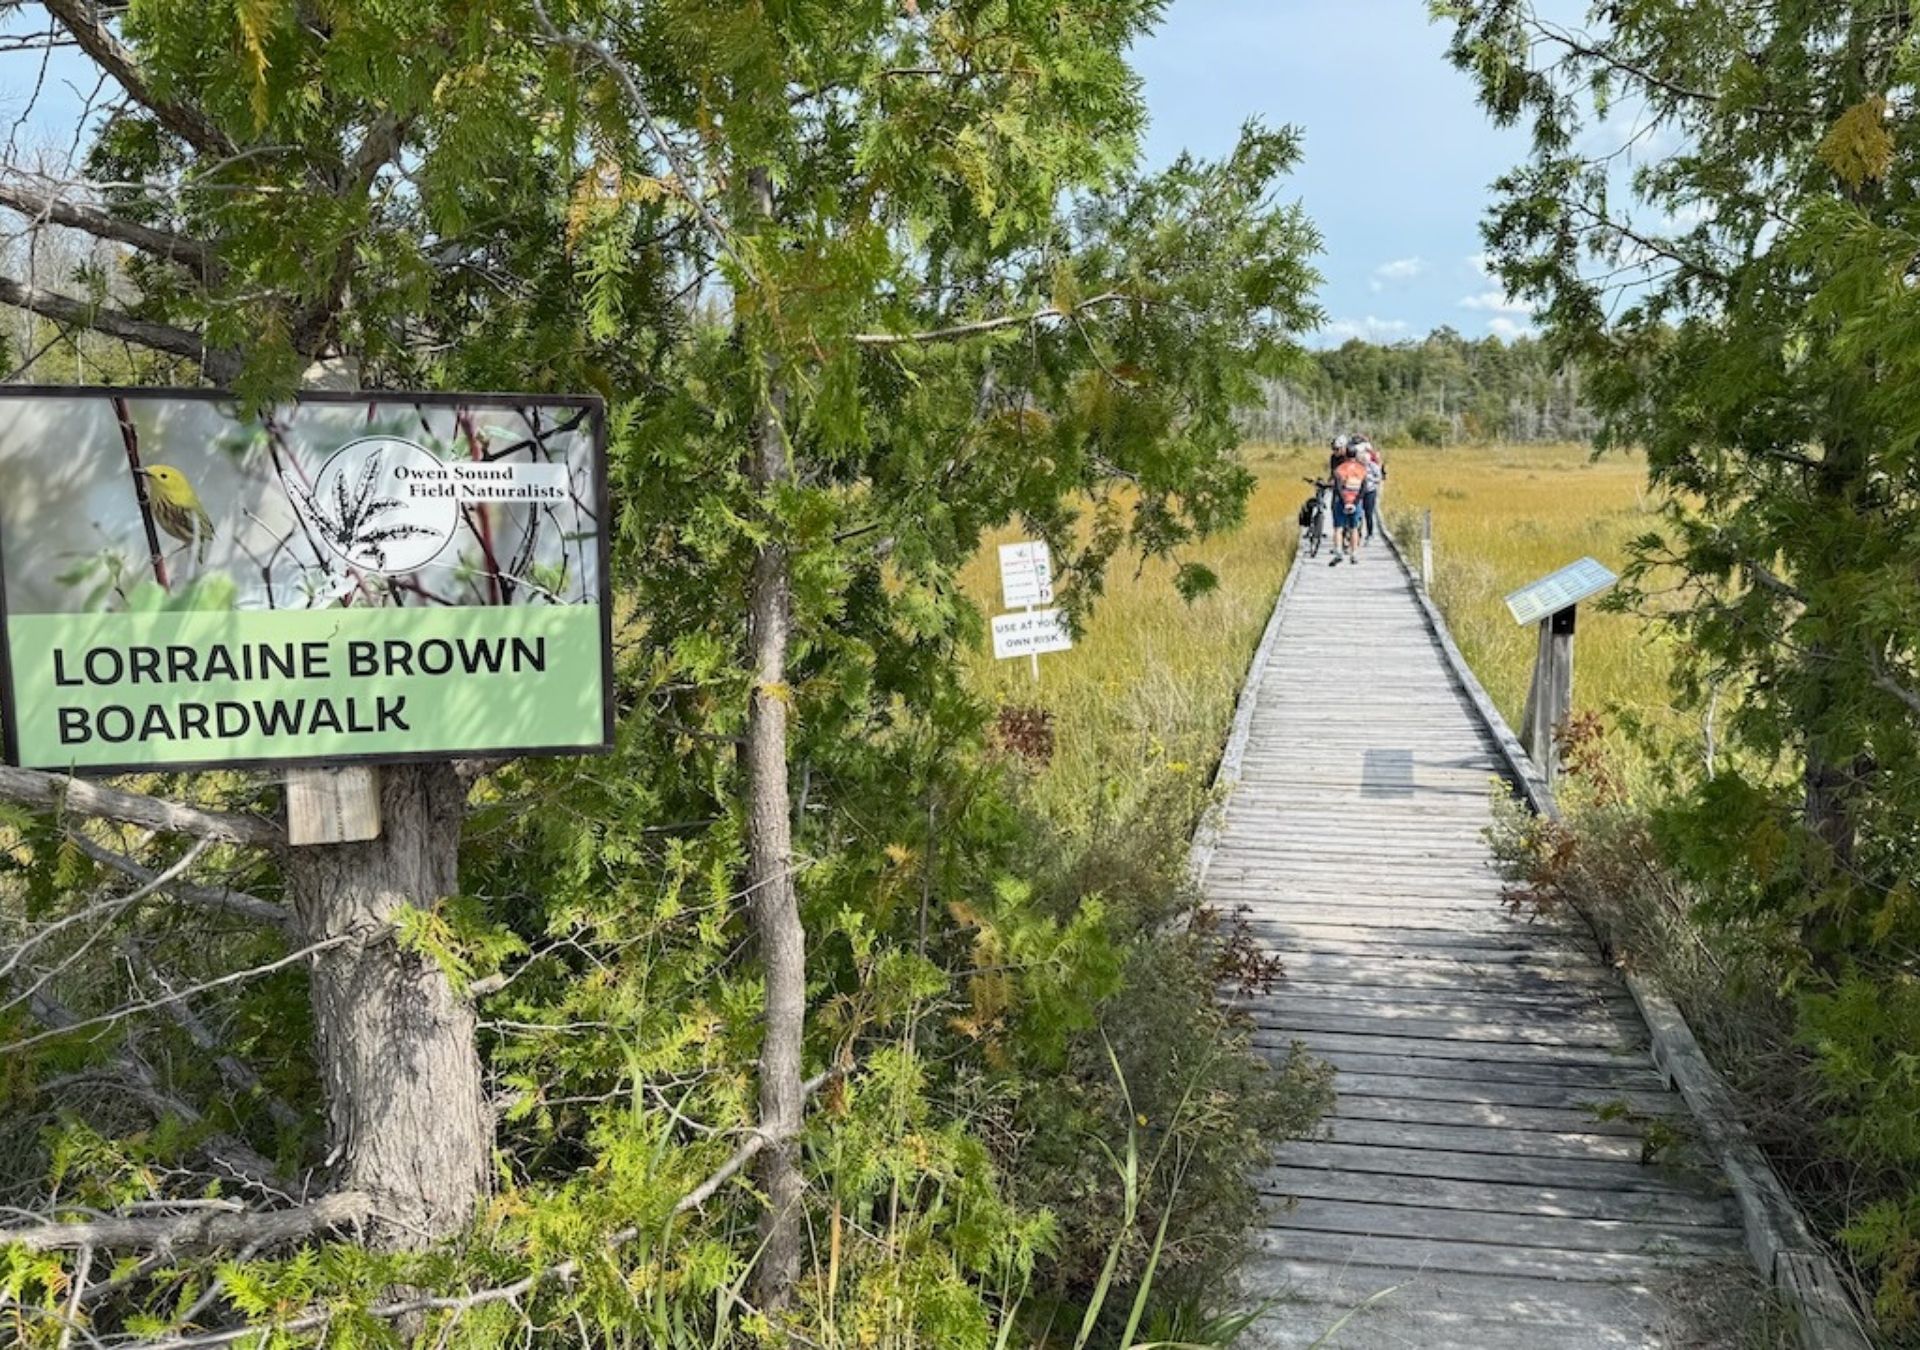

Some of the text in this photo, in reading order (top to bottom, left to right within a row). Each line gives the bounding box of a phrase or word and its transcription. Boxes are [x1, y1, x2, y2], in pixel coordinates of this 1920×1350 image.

[394, 465, 513, 480] Owen Sound
[409, 483, 565, 498] Field Naturalists
[995, 624, 1016, 633] USE
[1021, 619, 1033, 630] AT
[1006, 633, 1058, 648] OWN RISK
[53, 636, 547, 687] LORRAINE BROWN
[58, 695, 411, 745] BOARDWALK
